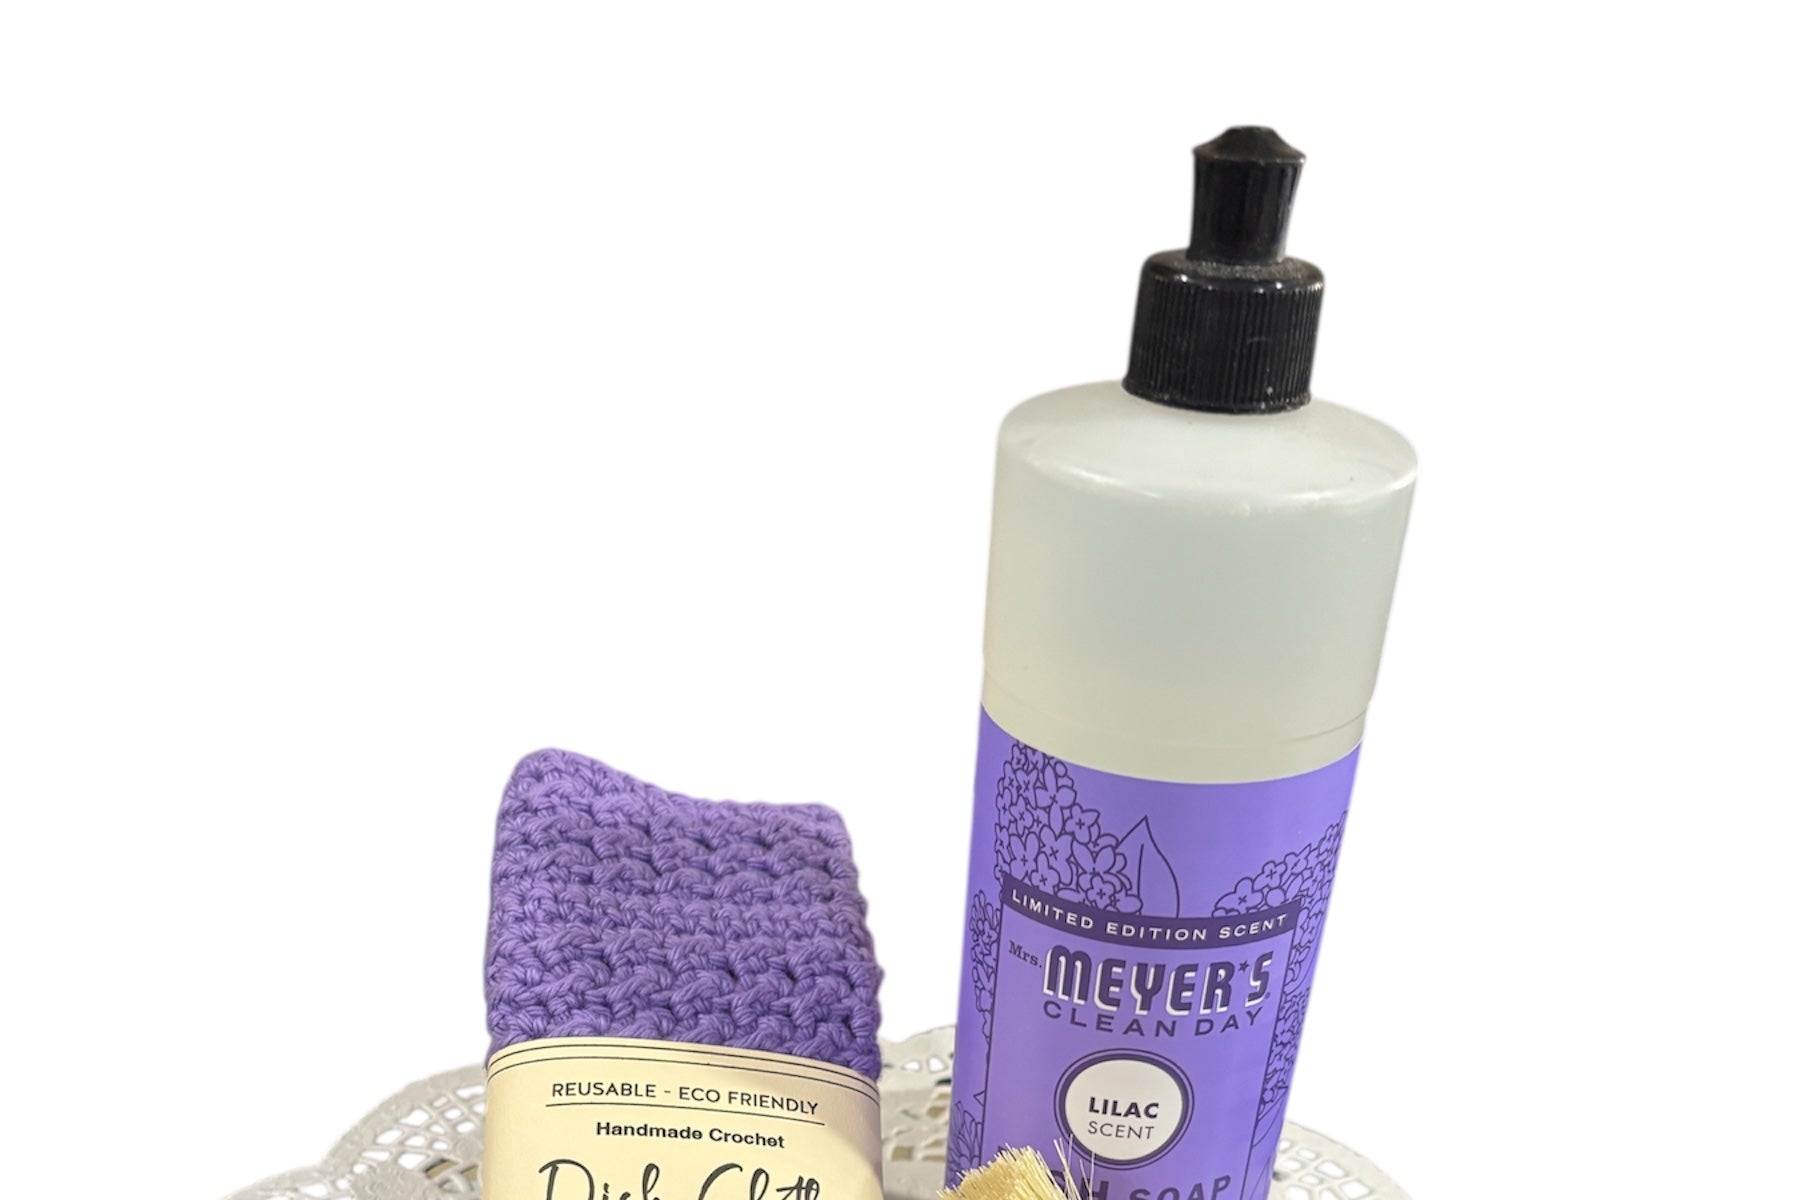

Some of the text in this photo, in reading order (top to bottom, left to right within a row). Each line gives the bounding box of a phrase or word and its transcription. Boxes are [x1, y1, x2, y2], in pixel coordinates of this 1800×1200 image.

[1012, 889, 1288, 940] LIMITED EDITION SCENT
[1009, 940, 1042, 968] Mrs.
[1043, 1000, 1263, 1037] CLEAN DAY
[552, 1082, 656, 1097] REUSABLE
[679, 1087, 720, 1102] ECO
[728, 1091, 818, 1115] FRIENDLY
[1088, 1096, 1159, 1119] LILAC
[596, 1122, 785, 1149] Handmade Crochet
[1088, 1120, 1154, 1140] SCENT
